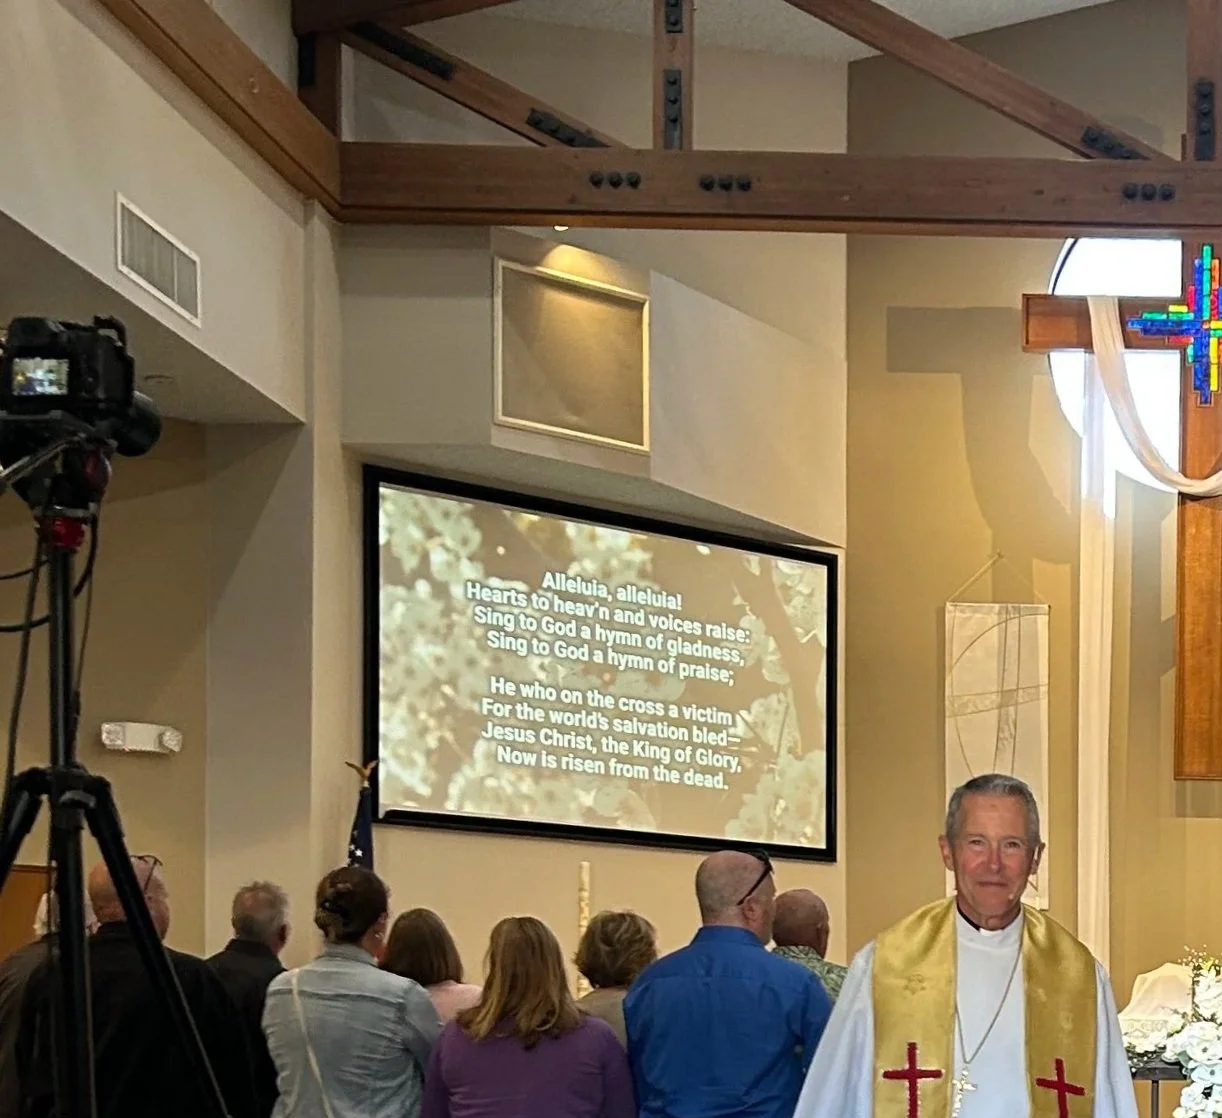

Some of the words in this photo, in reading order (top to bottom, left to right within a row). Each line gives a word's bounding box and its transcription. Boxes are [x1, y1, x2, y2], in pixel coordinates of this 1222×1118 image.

[466, 581, 528, 608] Hearts
[531, 592, 549, 611] to
[613, 608, 645, 626] and
[648, 614, 702, 635] voices
[705, 622, 750, 643] raise:
[542, 571, 612, 602] Alleluia,
[616, 584, 682, 611] alleluia!
[474, 605, 515, 632] Sing
[519, 613, 537, 631] to
[541, 616, 577, 638] God
[580, 626, 592, 639] a
[595, 623, 642, 647] hymn
[645, 633, 664, 650] of
[666, 637, 744, 667] gladness,
[487, 630, 528, 657] Sing
[531, 638, 550, 655] to
[554, 640, 589, 661] God
[593, 650, 604, 663] a
[607, 647, 654, 671] hymn
[657, 657, 676, 674] of
[679, 662, 734, 687] praise;
[481, 697, 513, 718] For
[515, 702, 545, 722] the
[612, 717, 689, 741] salvation
[490, 676, 516, 696] He
[520, 681, 557, 701] who
[560, 689, 583, 705] on
[586, 689, 615, 709] the
[618, 696, 665, 716] cross
[668, 704, 679, 718] a
[682, 704, 733, 726] victim
[481, 721, 536, 744] Jesus
[540, 727, 597, 754] Christ,
[601, 735, 629, 755] the
[632, 740, 671, 764] King
[674, 746, 693, 763] of
[695, 748, 742, 773] Glory,
[497, 745, 537, 766] Now
[541, 750, 558, 769] is
[561, 753, 605, 775] risen
[609, 757, 649, 780] from
[653, 764, 680, 784] the
[683, 768, 729, 790] dead.
